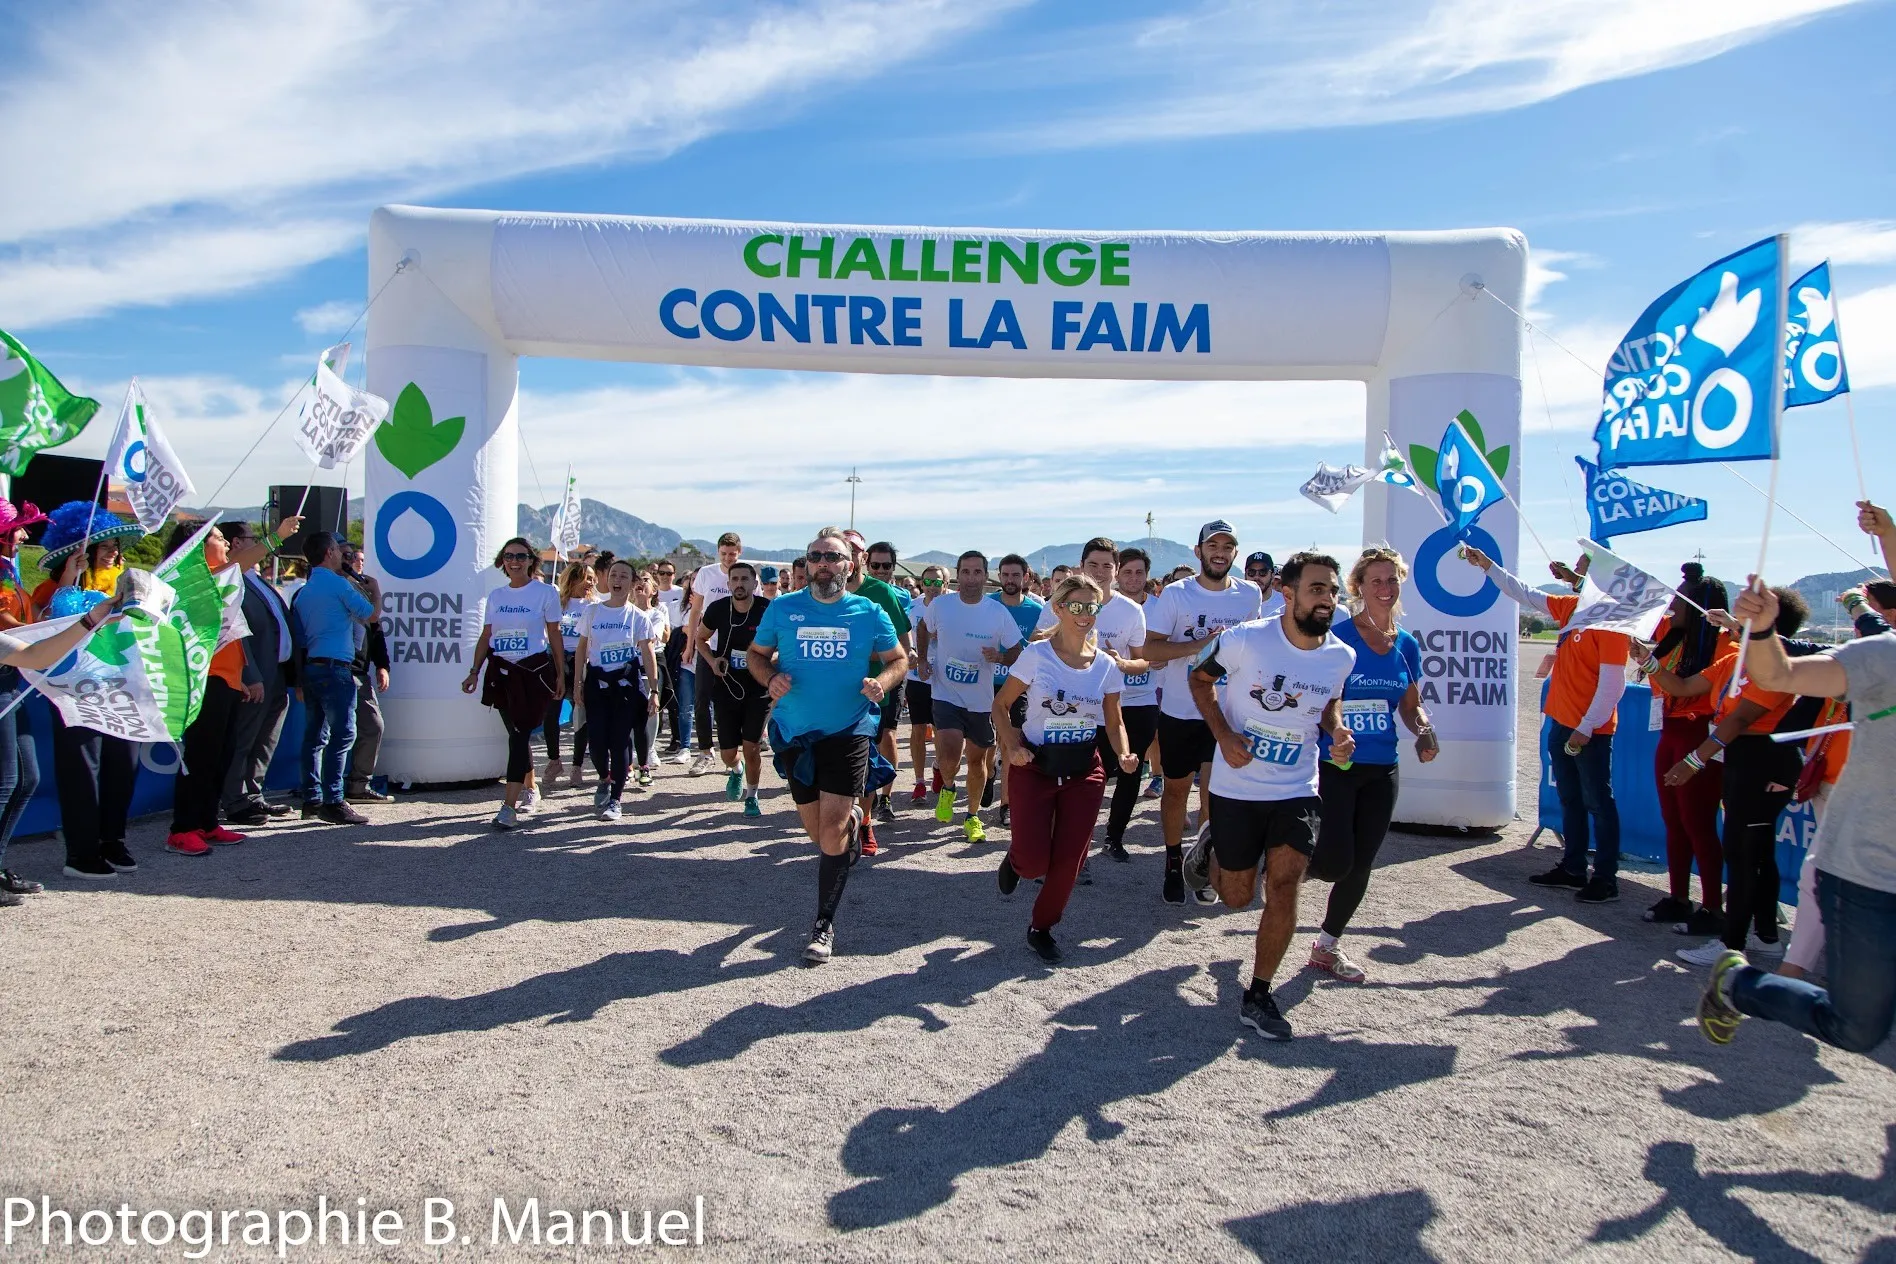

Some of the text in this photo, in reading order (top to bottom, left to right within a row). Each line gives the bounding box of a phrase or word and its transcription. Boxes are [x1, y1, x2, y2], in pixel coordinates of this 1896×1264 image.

[743, 234, 1131, 286] CHALLENGE
[659, 287, 1211, 353] CONTRE LA FAIM
[1598, 494, 1698, 524] LA FAIM
[381, 591, 463, 614] CTION
[380, 616, 463, 638] ONTRE
[393, 641, 462, 664] FAIM
[496, 638, 526, 651] 1762
[800, 640, 848, 659] 1695
[1411, 629, 1508, 654] ACTION
[602, 650, 632, 663] 1874
[732, 657, 748, 668] 16
[1421, 656, 1508, 679] ONTRE
[947, 667, 979, 682] 1677
[1420, 681, 1508, 706] A FAIM
[1343, 713, 1388, 731] 1816
